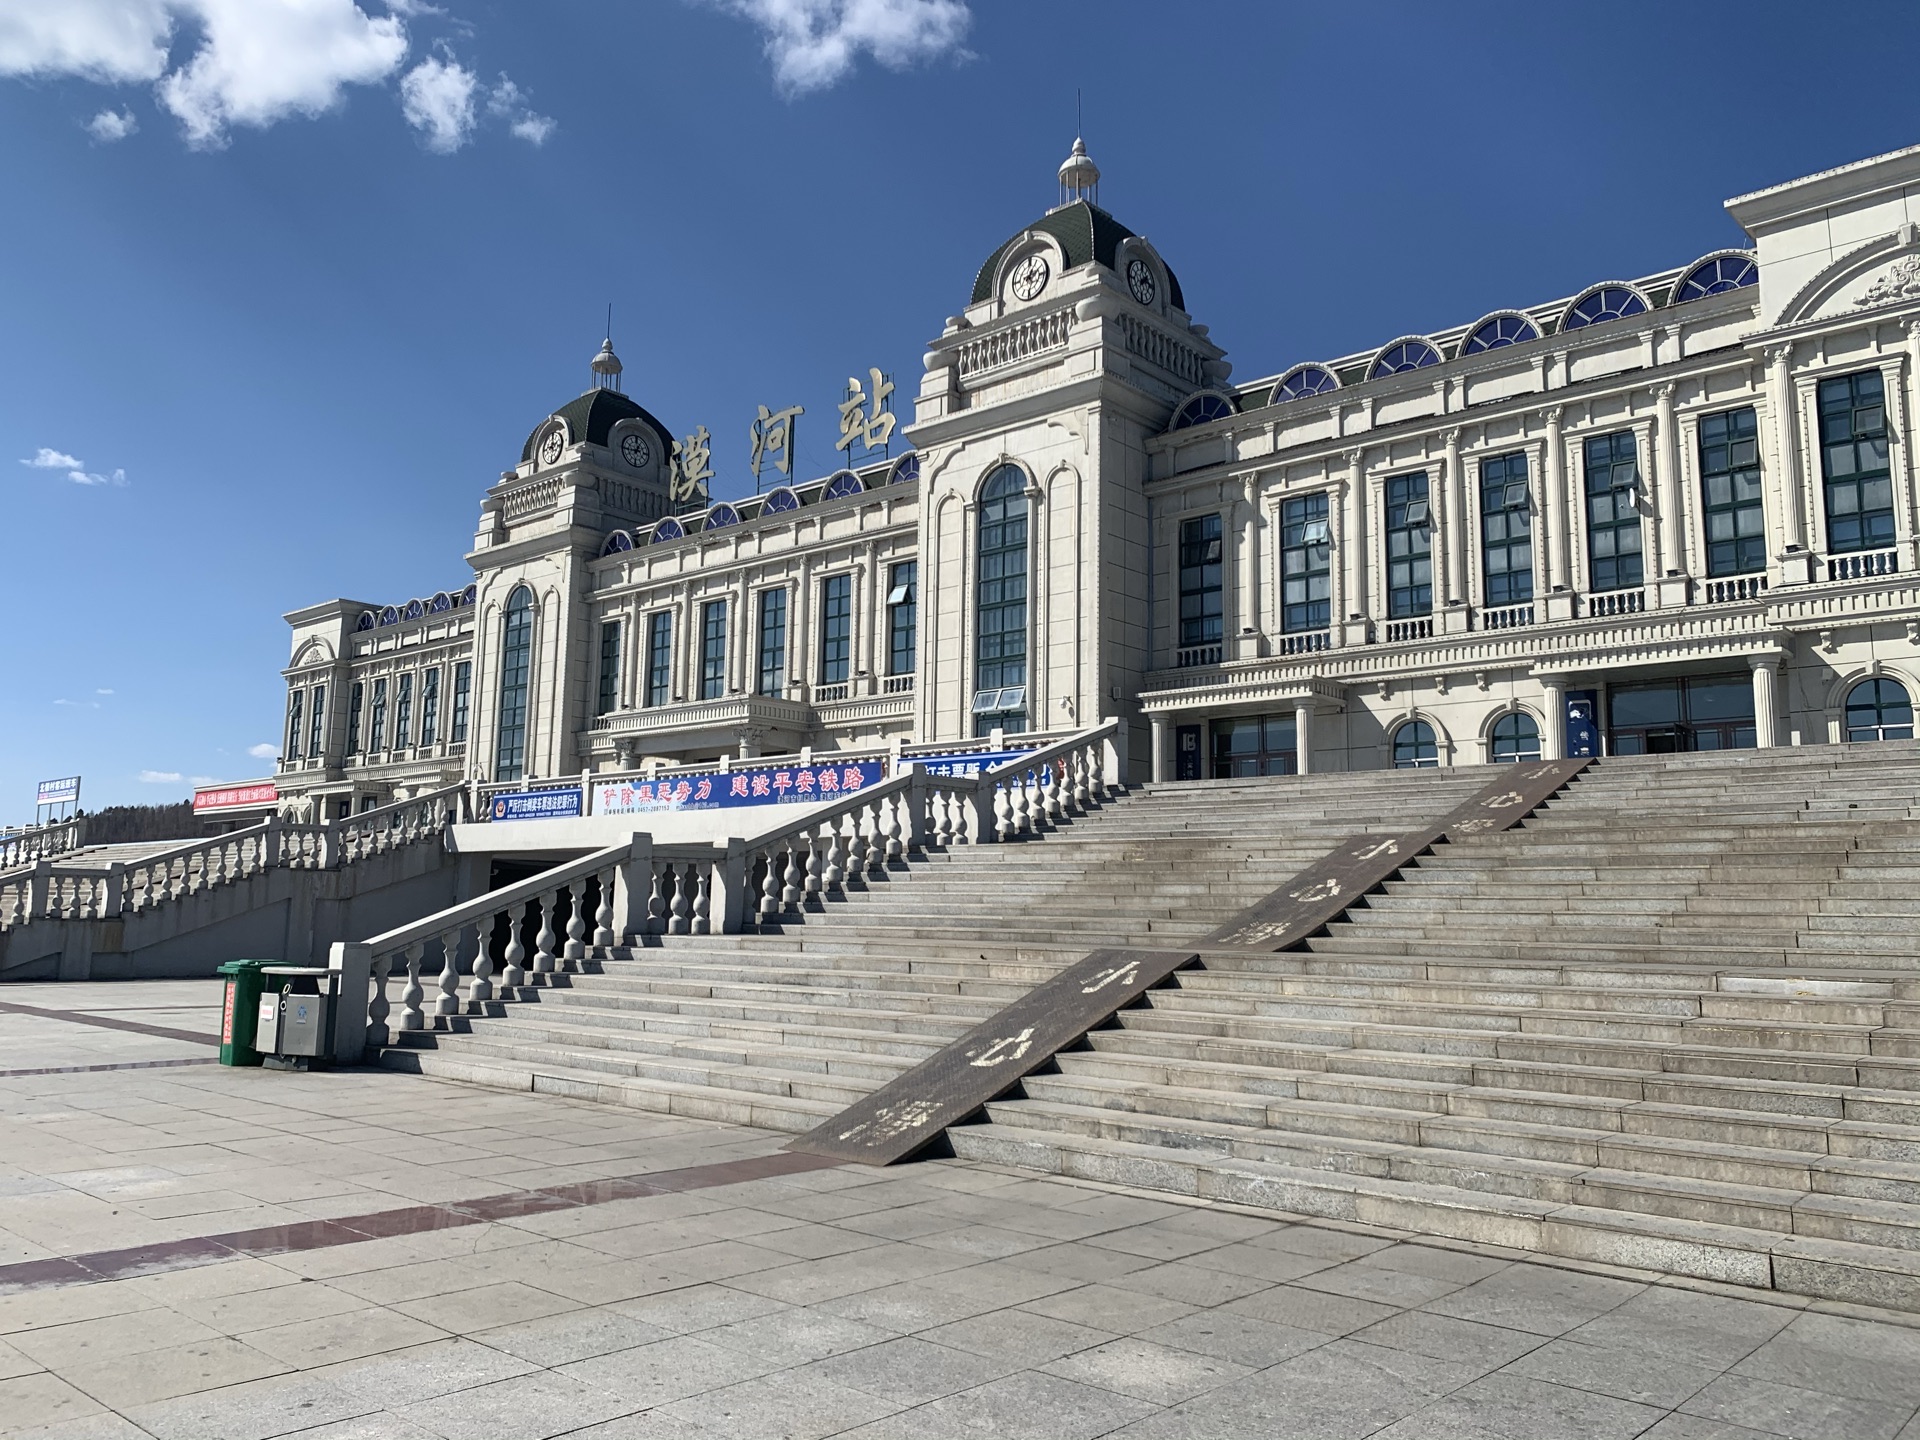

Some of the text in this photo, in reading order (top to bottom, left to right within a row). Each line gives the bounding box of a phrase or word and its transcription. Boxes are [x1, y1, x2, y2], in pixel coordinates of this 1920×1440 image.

[669, 367, 896, 502] 漠河站
[603, 766, 865, 807] 铲除黑恶势力 建设平安铁路
